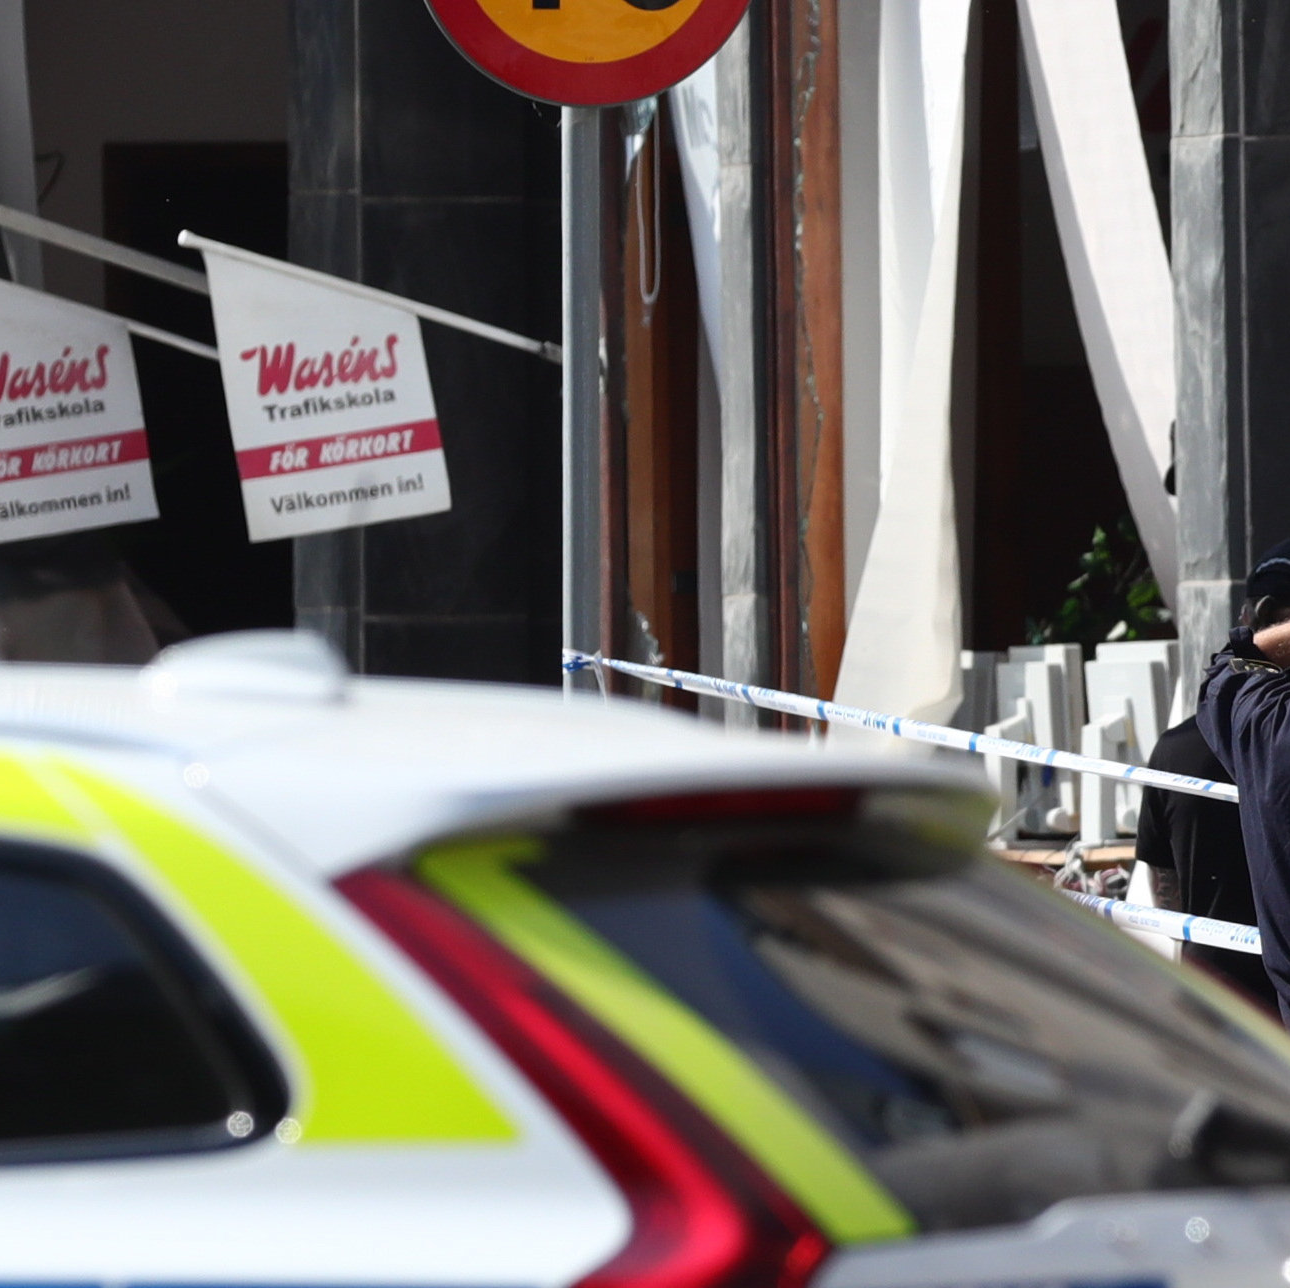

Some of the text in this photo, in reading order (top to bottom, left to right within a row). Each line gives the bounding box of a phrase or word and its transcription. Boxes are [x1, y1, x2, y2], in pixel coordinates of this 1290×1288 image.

[263, 387, 396, 422] Trafikskola
[32, 440, 122, 472] KÖRKORT
[269, 429, 414, 473] FÖR KÖRKORT
[106, 482, 131, 502] in!
[270, 473, 425, 514] Välkommen in!
